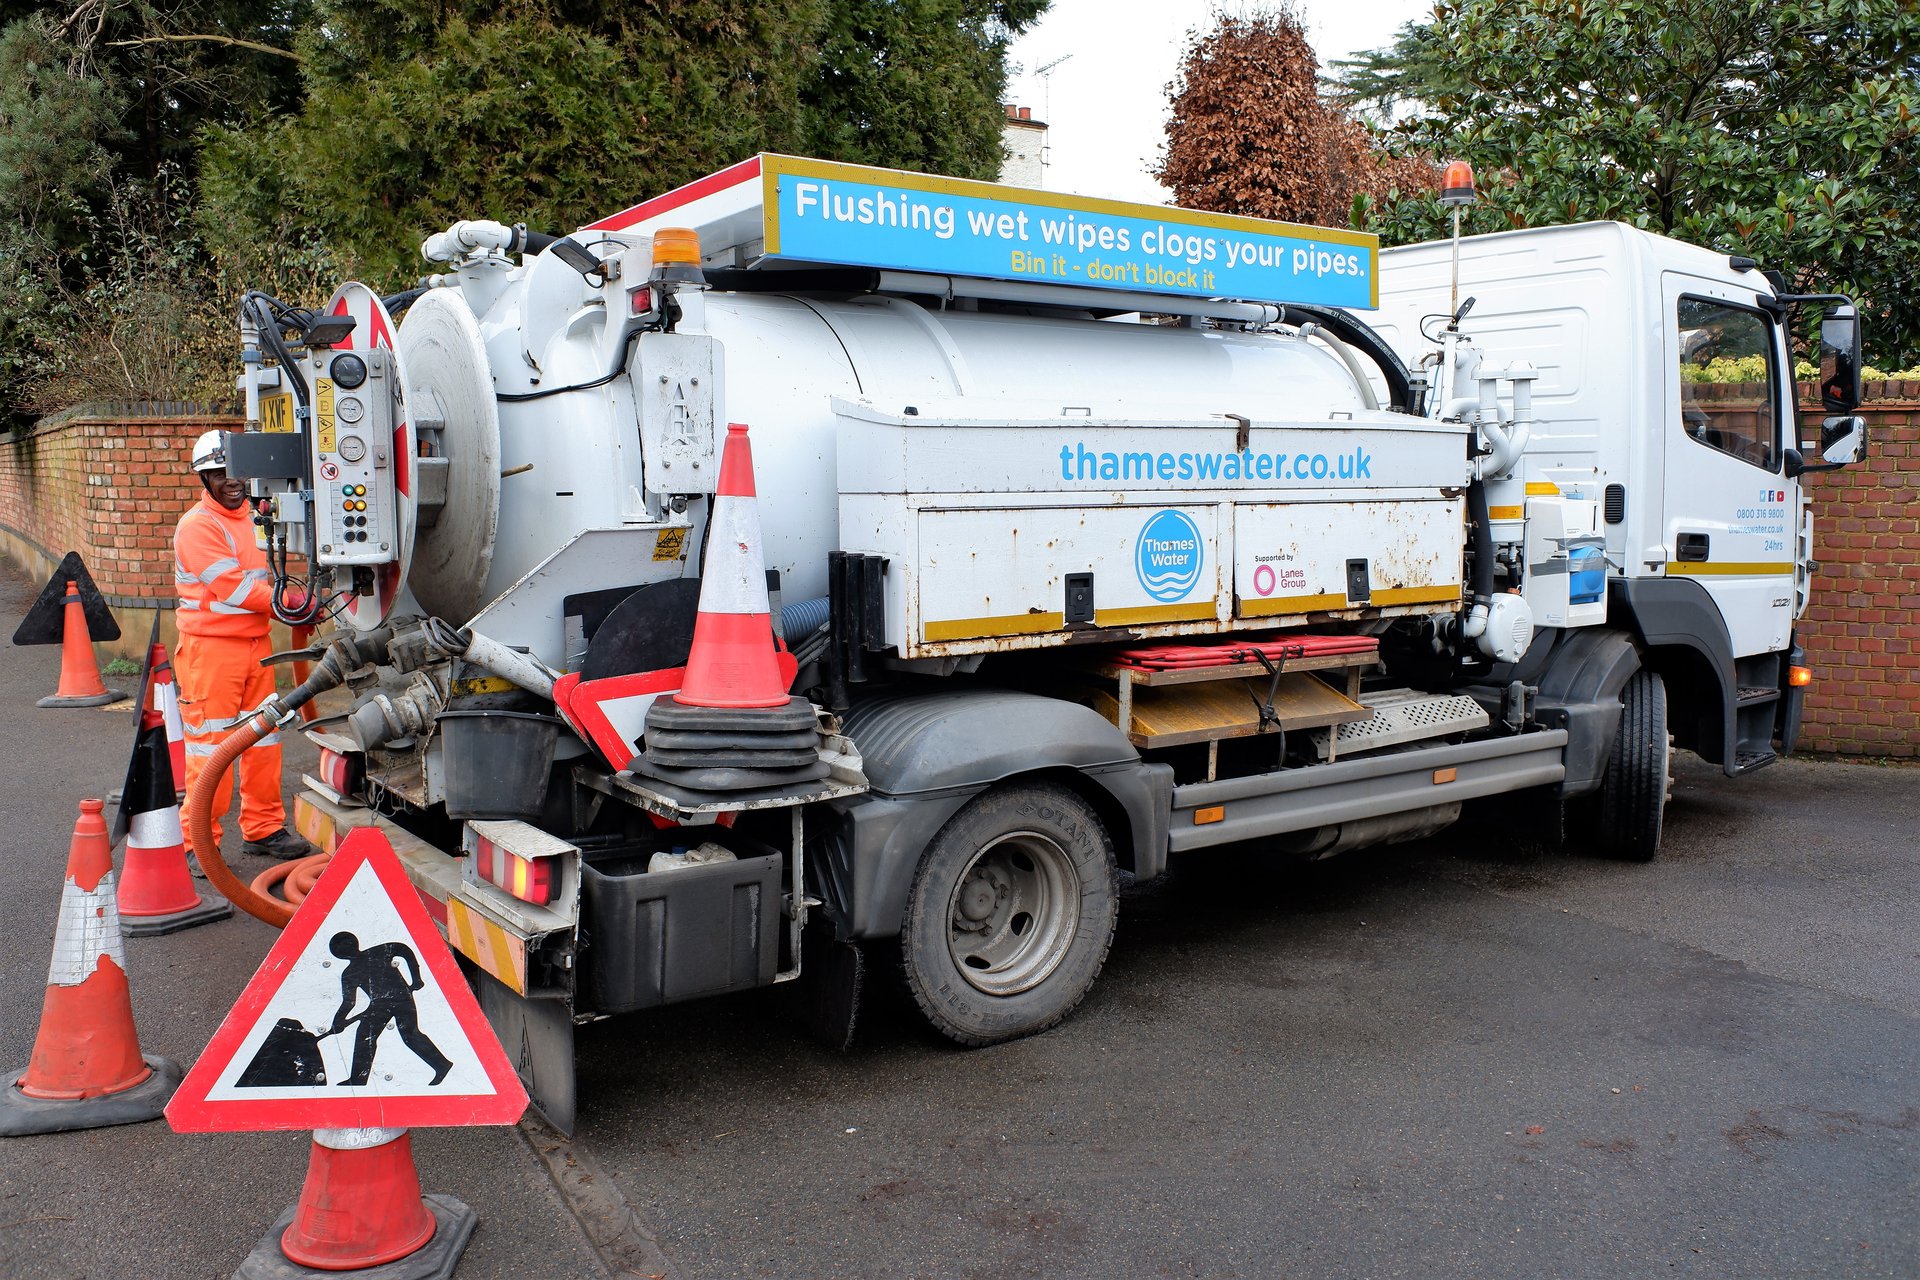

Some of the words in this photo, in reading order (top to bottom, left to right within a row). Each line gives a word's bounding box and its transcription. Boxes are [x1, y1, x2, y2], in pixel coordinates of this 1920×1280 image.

[796, 183, 955, 239] Flushing
[967, 210, 1029, 241] wet
[1040, 214, 1130, 253] wipes
[1141, 225, 1217, 265] clogs
[1225, 239, 1285, 269] your
[1292, 244, 1365, 278] pipes.
[1011, 250, 1046, 274] Bin
[1052, 253, 1067, 276] it
[1087, 258, 1139, 283] don't
[1145, 264, 1198, 289] block
[1203, 269, 1216, 290] it
[1060, 442, 1371, 481] thameswater.co.uk
[1737, 509, 1755, 519] 0800
[1756, 509, 1766, 519] 316
[1768, 509, 1784, 519] 9800
[1145, 539, 1194, 553] Thames
[1764, 540, 1783, 551] 24hrs
[1150, 553, 1189, 567] Water
[1255, 554, 1285, 562] Supported
[1286, 554, 1294, 562] by
[1280, 569, 1304, 578] Lanes
[1280, 579, 1306, 589] Group
[1037, 808, 1098, 860] OTANI
